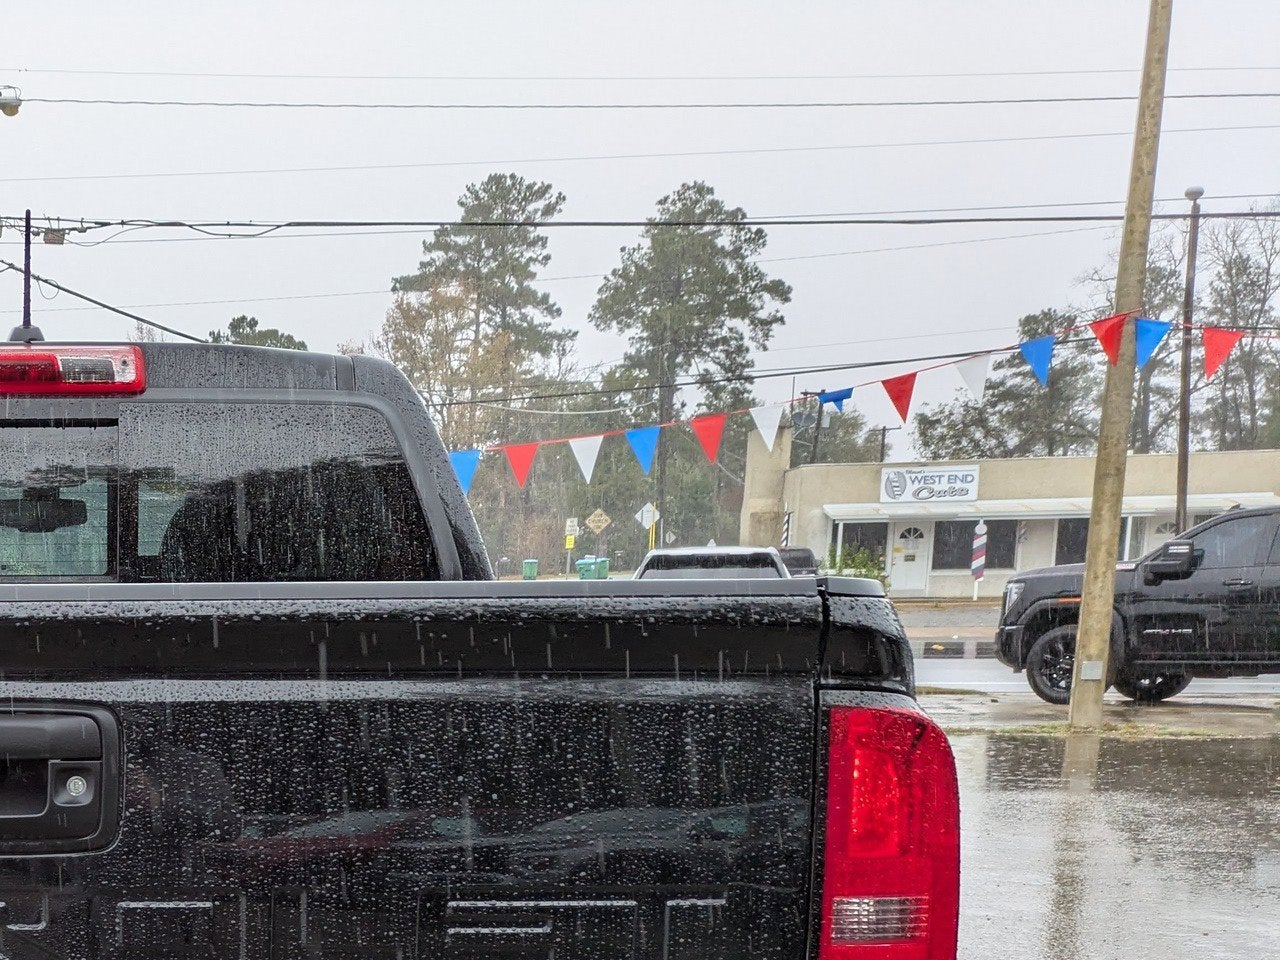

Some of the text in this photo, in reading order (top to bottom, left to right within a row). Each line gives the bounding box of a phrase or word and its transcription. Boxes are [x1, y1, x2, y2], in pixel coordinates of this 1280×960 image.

[910, 473, 975, 485] WEST END
[911, 485, 969, 500] Cuts
